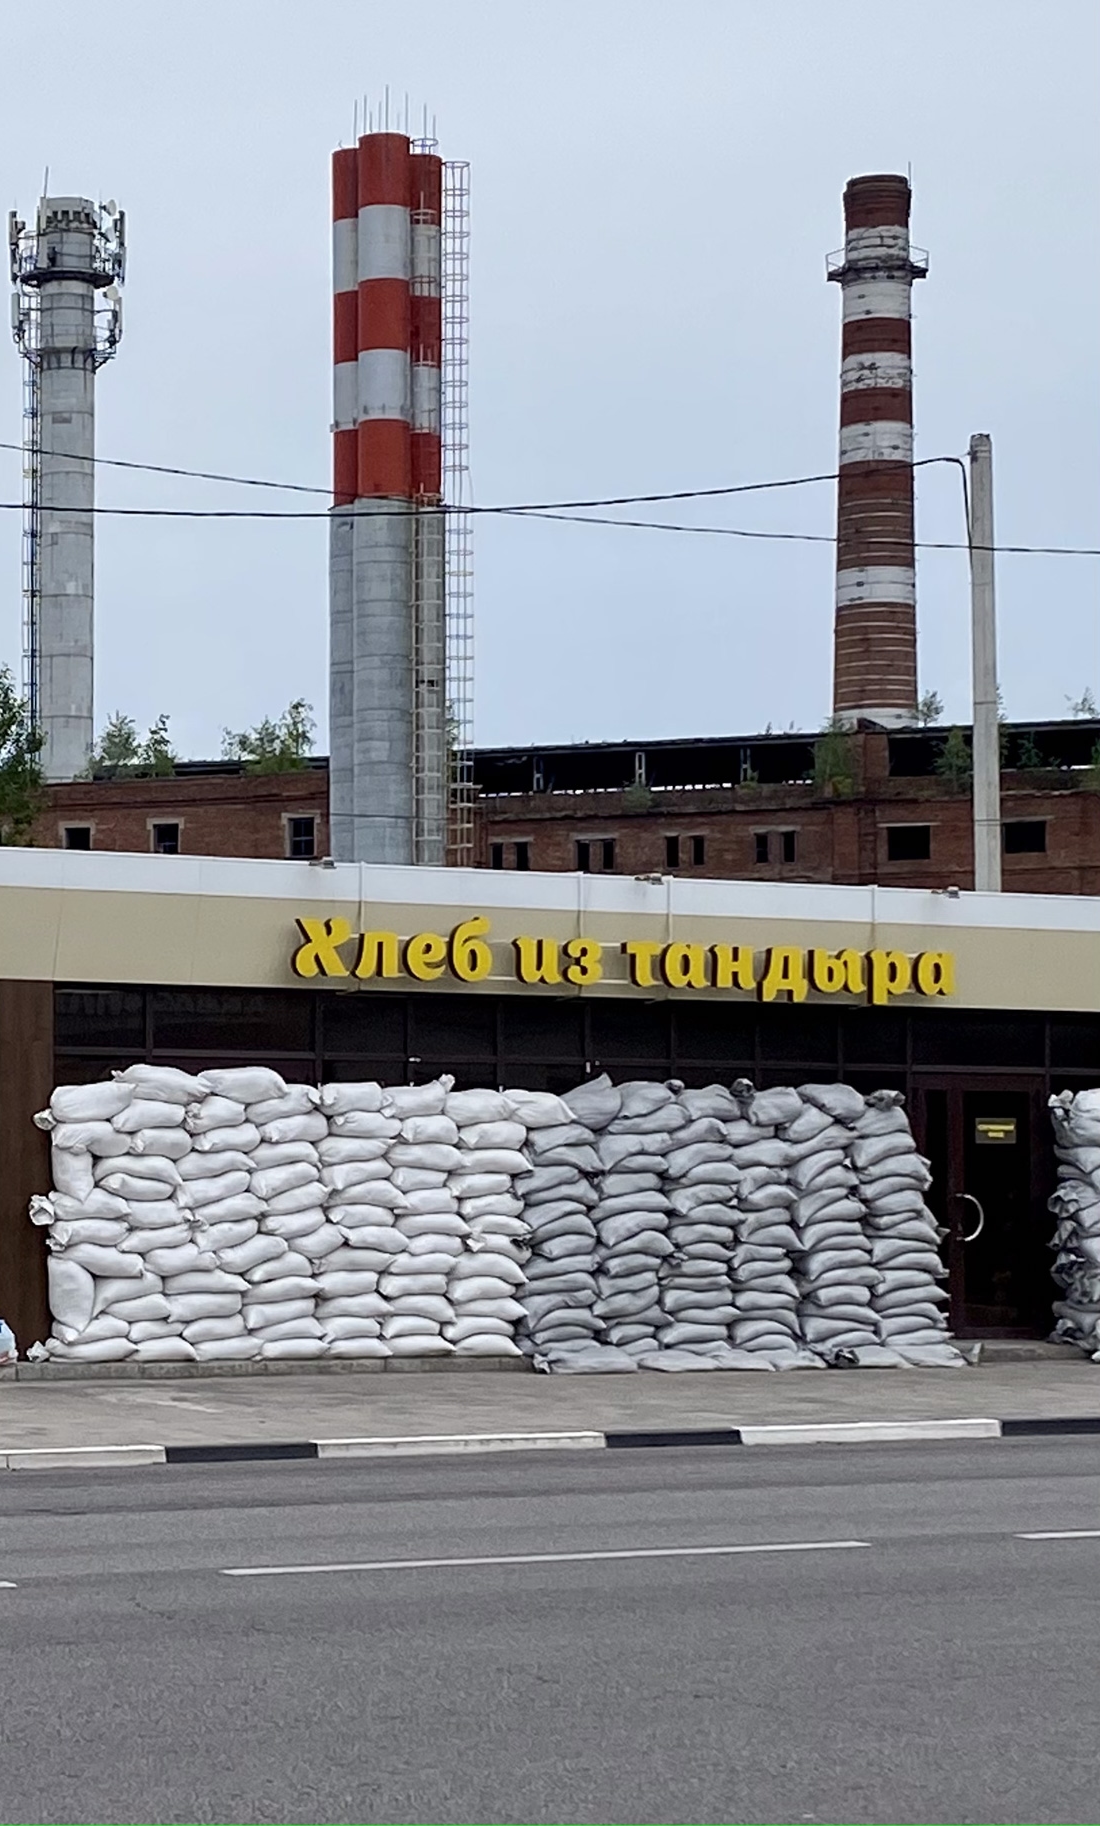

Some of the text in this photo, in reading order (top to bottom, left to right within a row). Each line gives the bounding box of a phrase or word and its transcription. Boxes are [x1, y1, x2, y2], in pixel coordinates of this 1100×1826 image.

[294, 916, 956, 1005] Хлеб из тандыра
